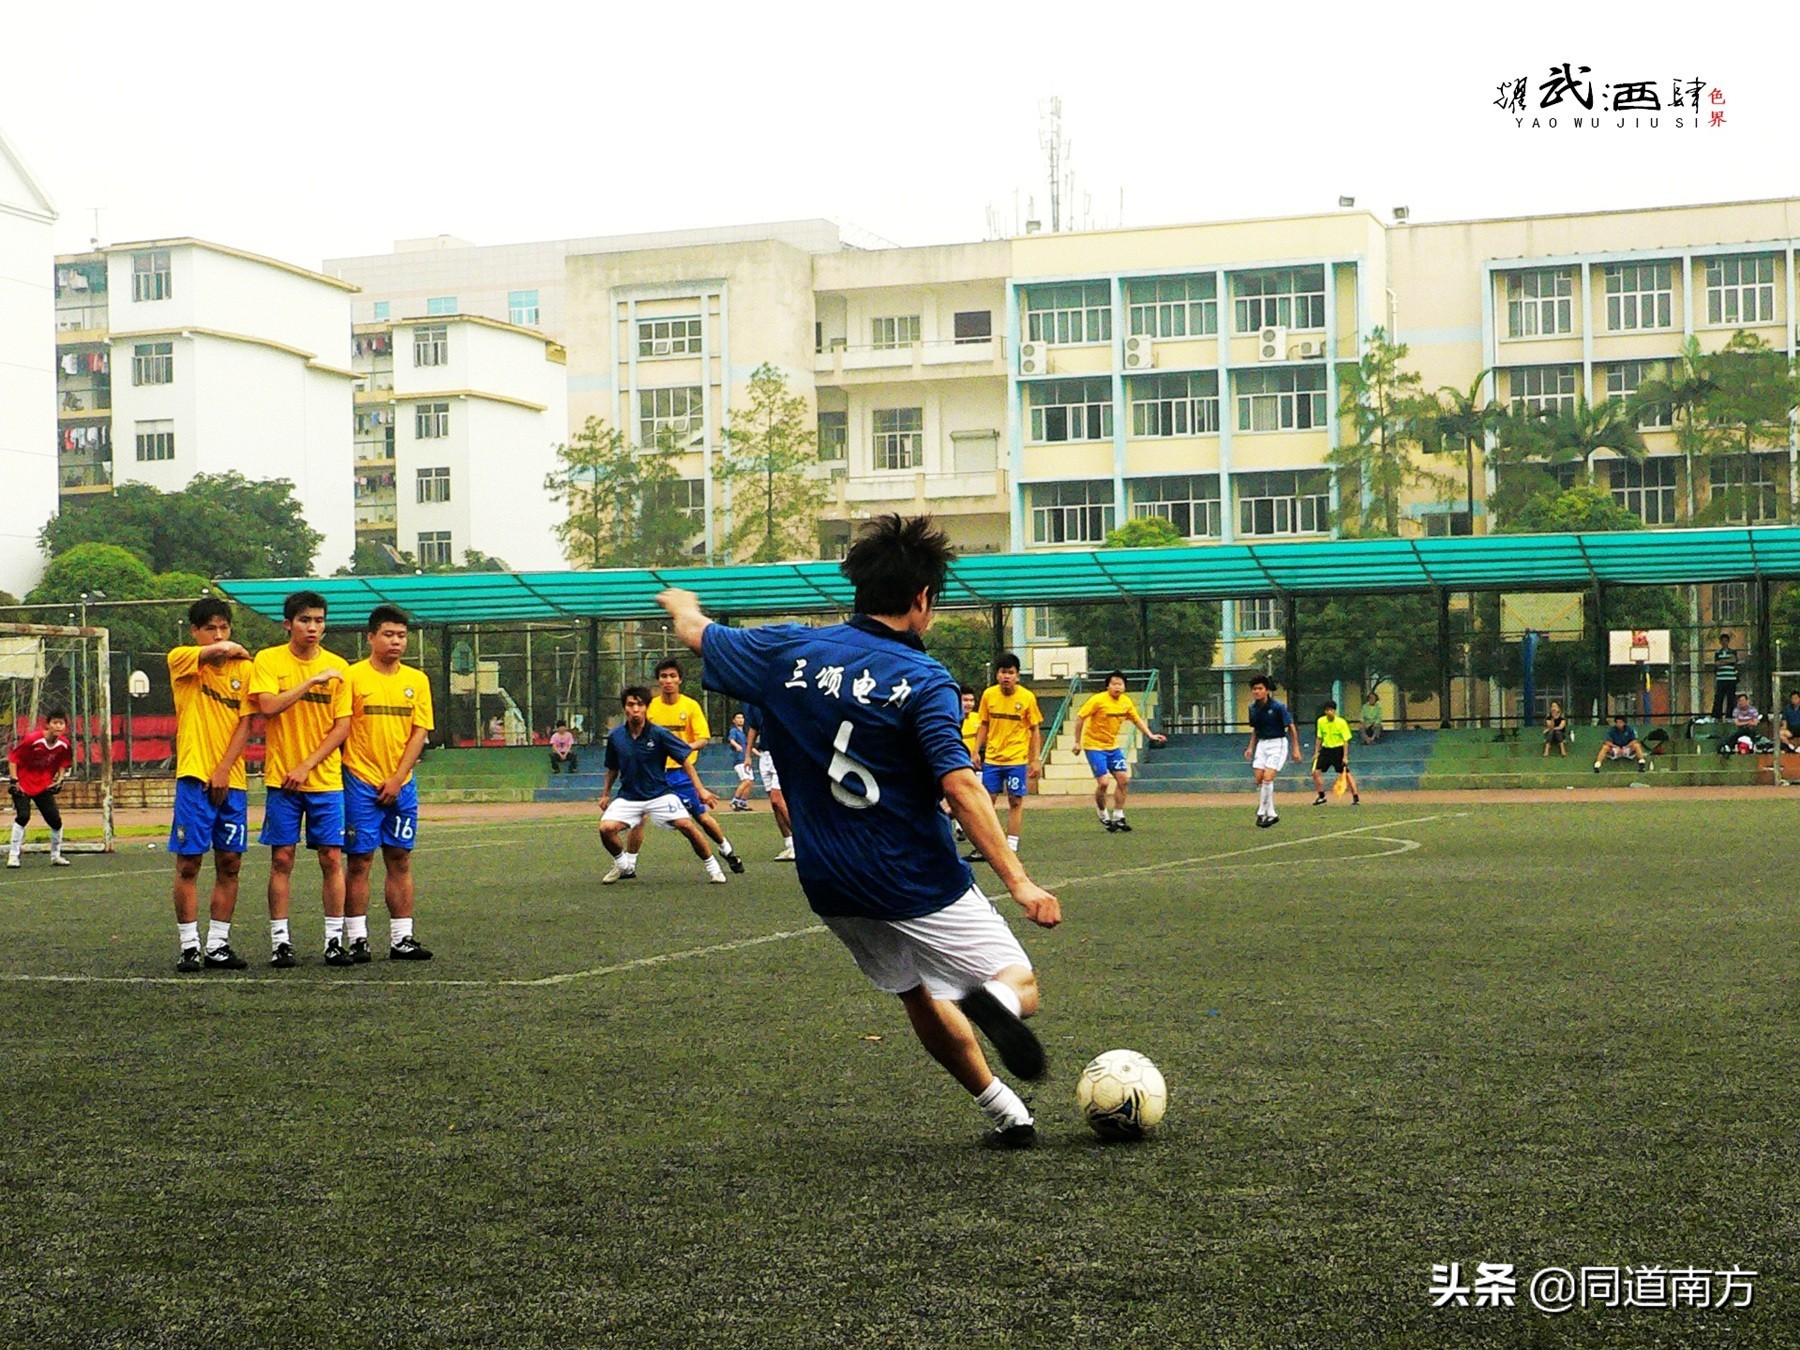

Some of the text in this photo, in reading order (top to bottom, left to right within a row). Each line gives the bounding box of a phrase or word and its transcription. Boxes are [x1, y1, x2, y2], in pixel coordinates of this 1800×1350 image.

[828, 720, 881, 810] 6
[224, 823, 246, 846] 71
[393, 815, 413, 839] 16
